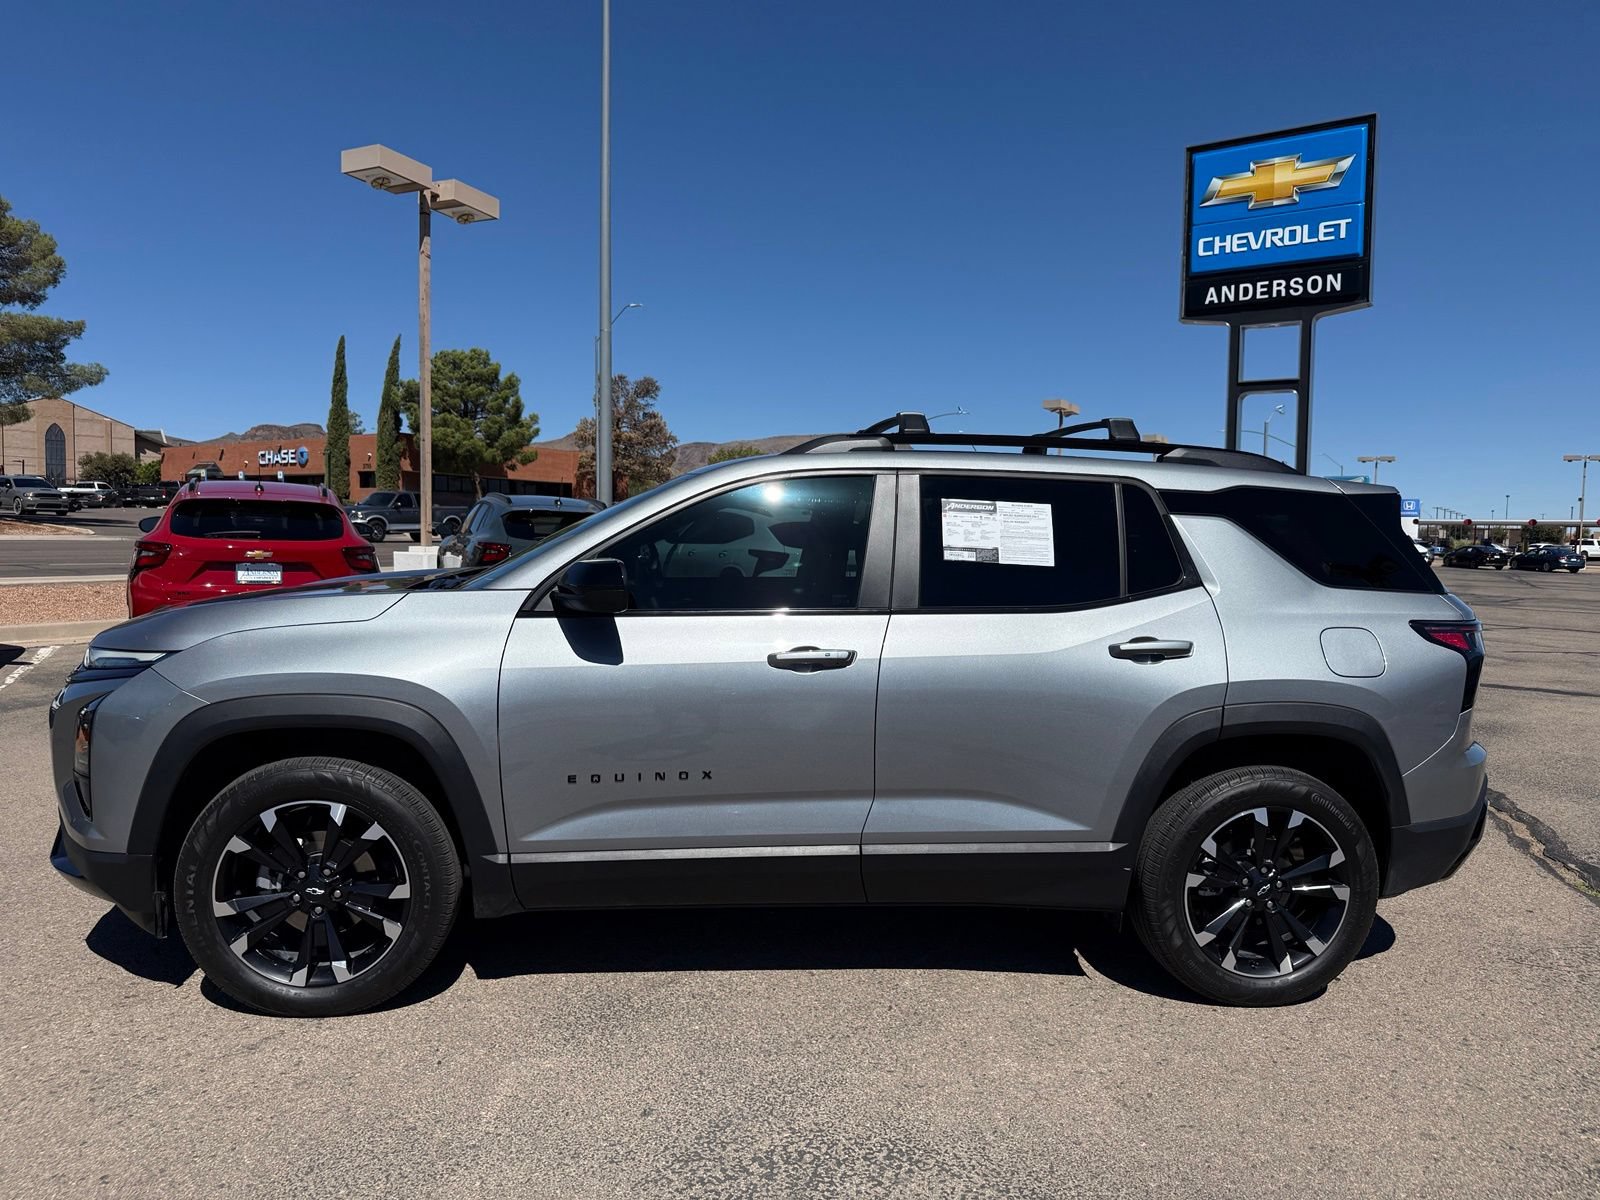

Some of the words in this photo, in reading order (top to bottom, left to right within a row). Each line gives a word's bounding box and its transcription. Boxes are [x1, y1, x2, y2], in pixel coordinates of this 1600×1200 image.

[1198, 218, 1352, 257] CHEVROLET
[1205, 273, 1342, 305] ANDERSON
[258, 449, 297, 465] CHASE
[944, 502, 994, 511] ANDERSON
[567, 770, 713, 784] EQUINOX
